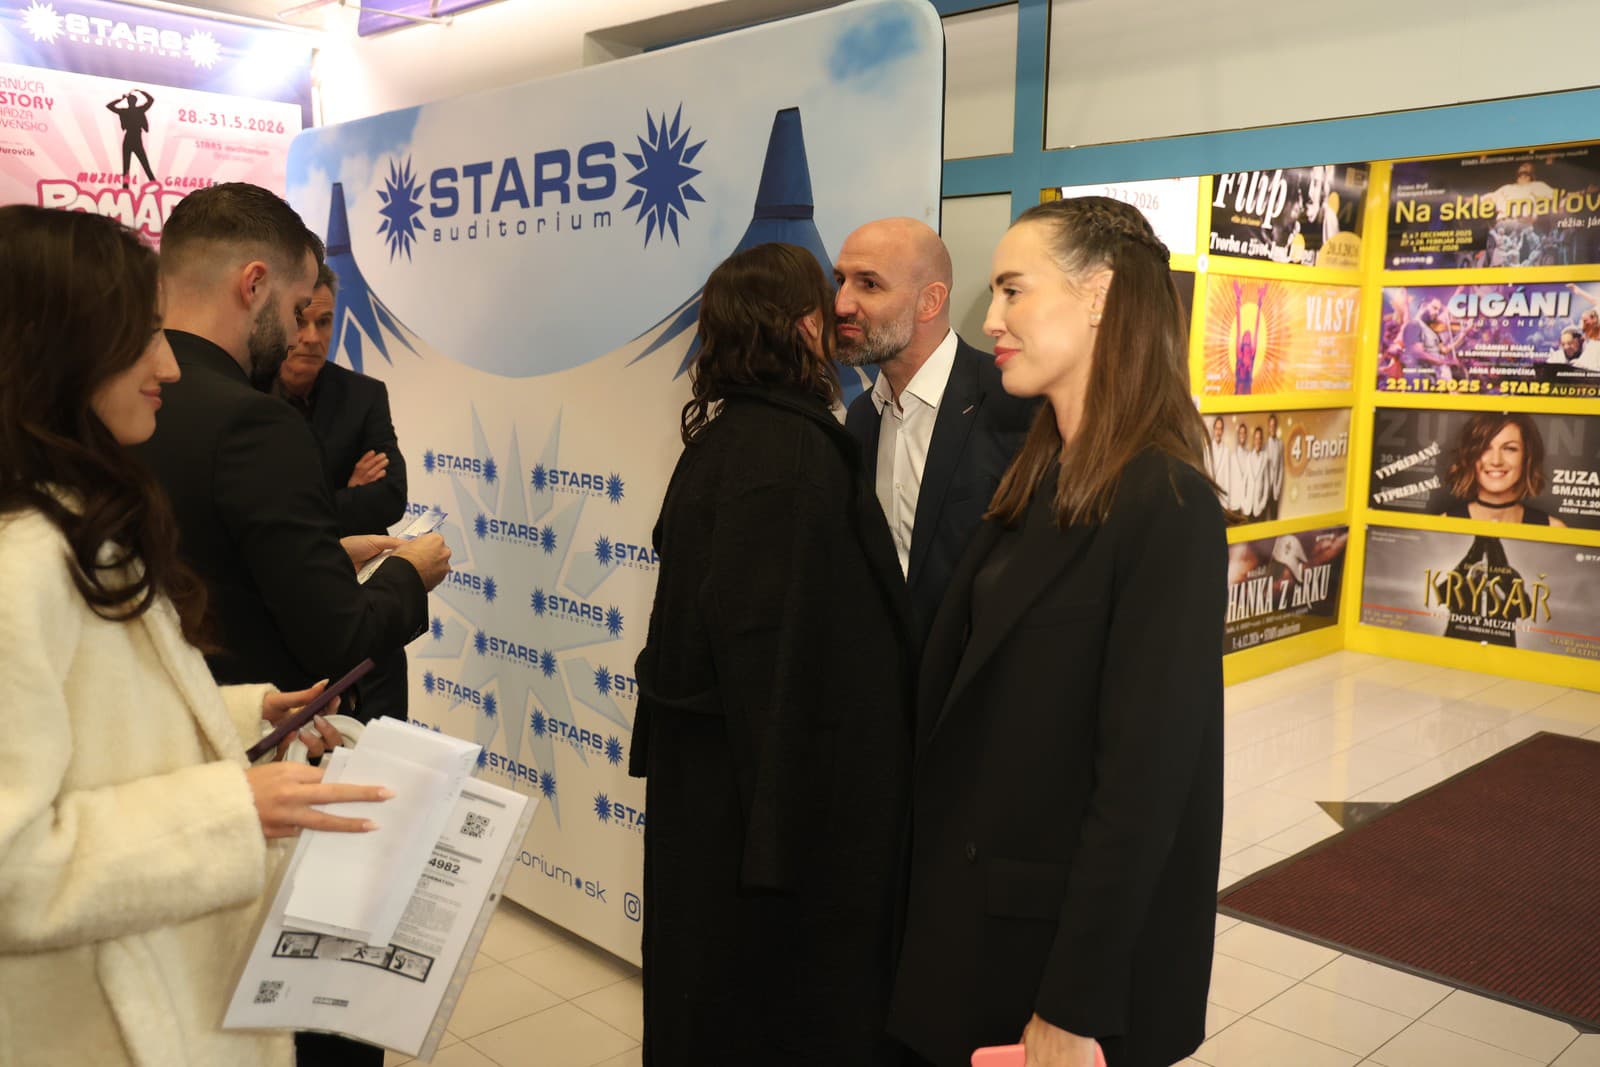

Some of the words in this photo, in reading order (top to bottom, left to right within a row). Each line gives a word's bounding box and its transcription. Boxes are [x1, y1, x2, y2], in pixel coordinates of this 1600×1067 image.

[64, 13, 184, 50] STARS
[430, 141, 616, 218] STARS
[1395, 200, 1431, 224] Na
[1440, 193, 1495, 220] skle
[433, 211, 612, 242] auditorium
[1306, 295, 1355, 333] VLASY
[1448, 287, 1571, 318] CIGÁNI
[1386, 377, 1481, 392] 22.11.2025
[1499, 380, 1551, 394] STARS
[1291, 435, 1303, 460] 4
[1305, 432, 1348, 460] Tenoři
[437, 453, 480, 473] STARS
[548, 470, 604, 491] STARS
[1552, 469, 1599, 486] ZUZA
[404, 503, 429, 516] ARS
[490, 519, 539, 542] STARS
[614, 543, 660, 565] STA
[446, 570, 481, 591] TARS
[548, 595, 603, 622] STARS
[1226, 575, 1274, 624] HANKA
[1423, 568, 1552, 624] KRYSAŘ
[490, 637, 538, 664] STARS
[437, 677, 481, 704] STARS
[548, 718, 603, 749] STARS
[489, 752, 538, 783] STARS
[614, 803, 646, 827] STA
